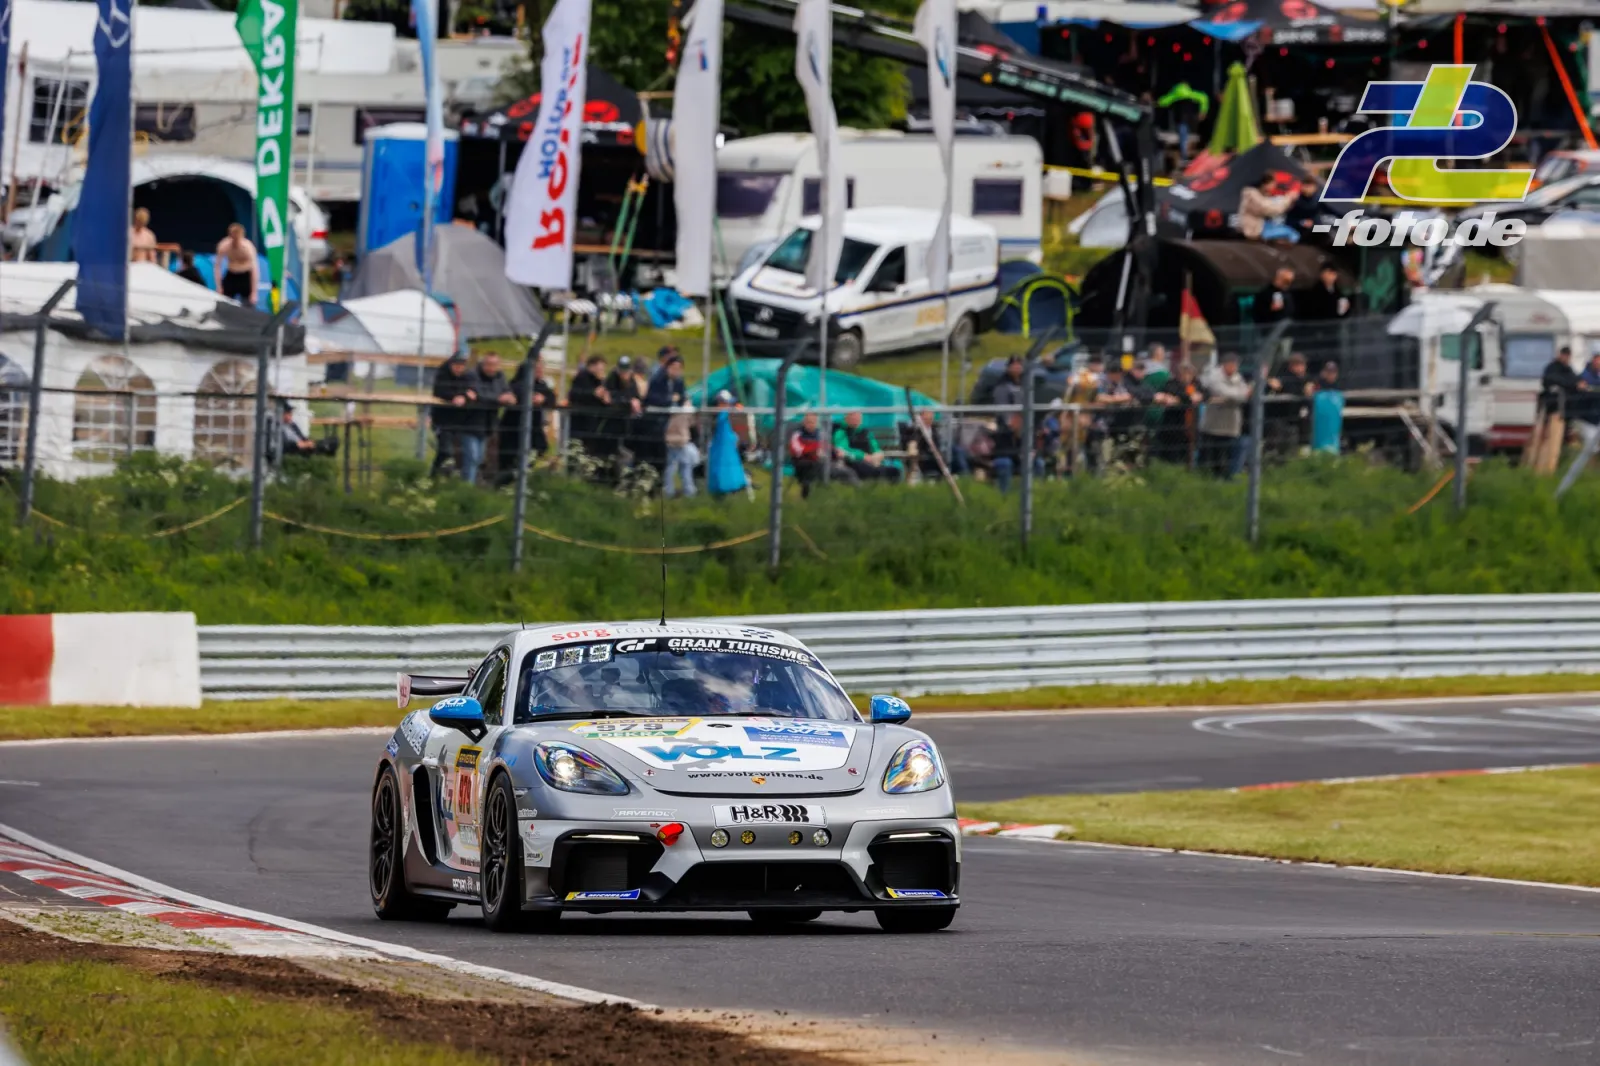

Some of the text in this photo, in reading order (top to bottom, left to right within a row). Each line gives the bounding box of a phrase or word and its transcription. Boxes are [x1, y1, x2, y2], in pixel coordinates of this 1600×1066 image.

[552, 625, 733, 641] sorg rennsport
[668, 638, 721, 649] GRAN
[757, 652, 809, 668] SIMULATOR
[597, 723, 663, 732] 979
[637, 745, 801, 762] VOLZ
[687, 770, 824, 781] www.volz-witten.de
[731, 805, 783, 823] H&R
